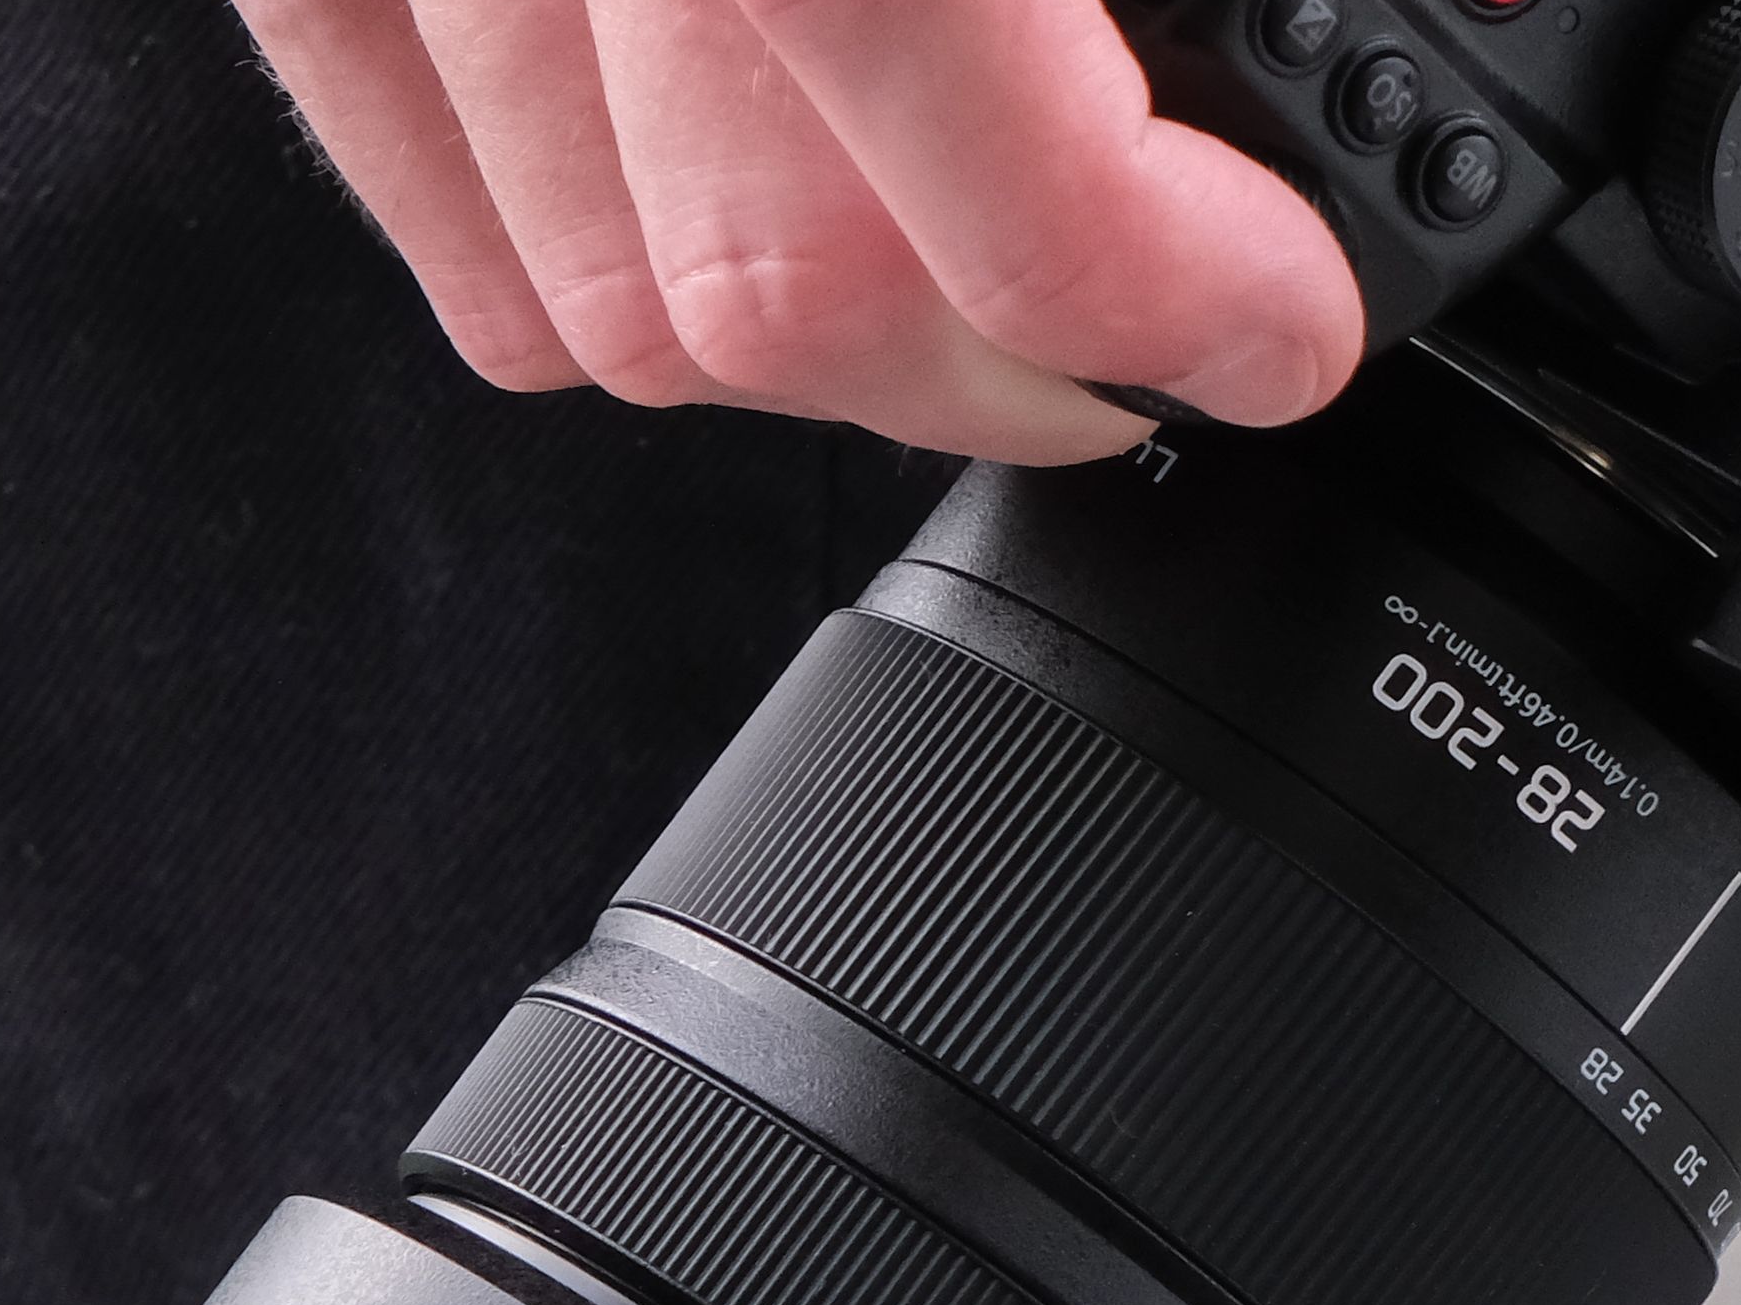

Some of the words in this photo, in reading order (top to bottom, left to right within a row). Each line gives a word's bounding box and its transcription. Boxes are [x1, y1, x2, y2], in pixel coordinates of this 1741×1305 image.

[1367, 73, 1418, 130] ISO
[1447, 149, 1497, 209] WB
[1372, 653, 1606, 853] 28-200
[1580, 1047, 1624, 1095] 28
[1621, 1089, 1662, 1134] 35
[1674, 1145, 1707, 1186] 50
